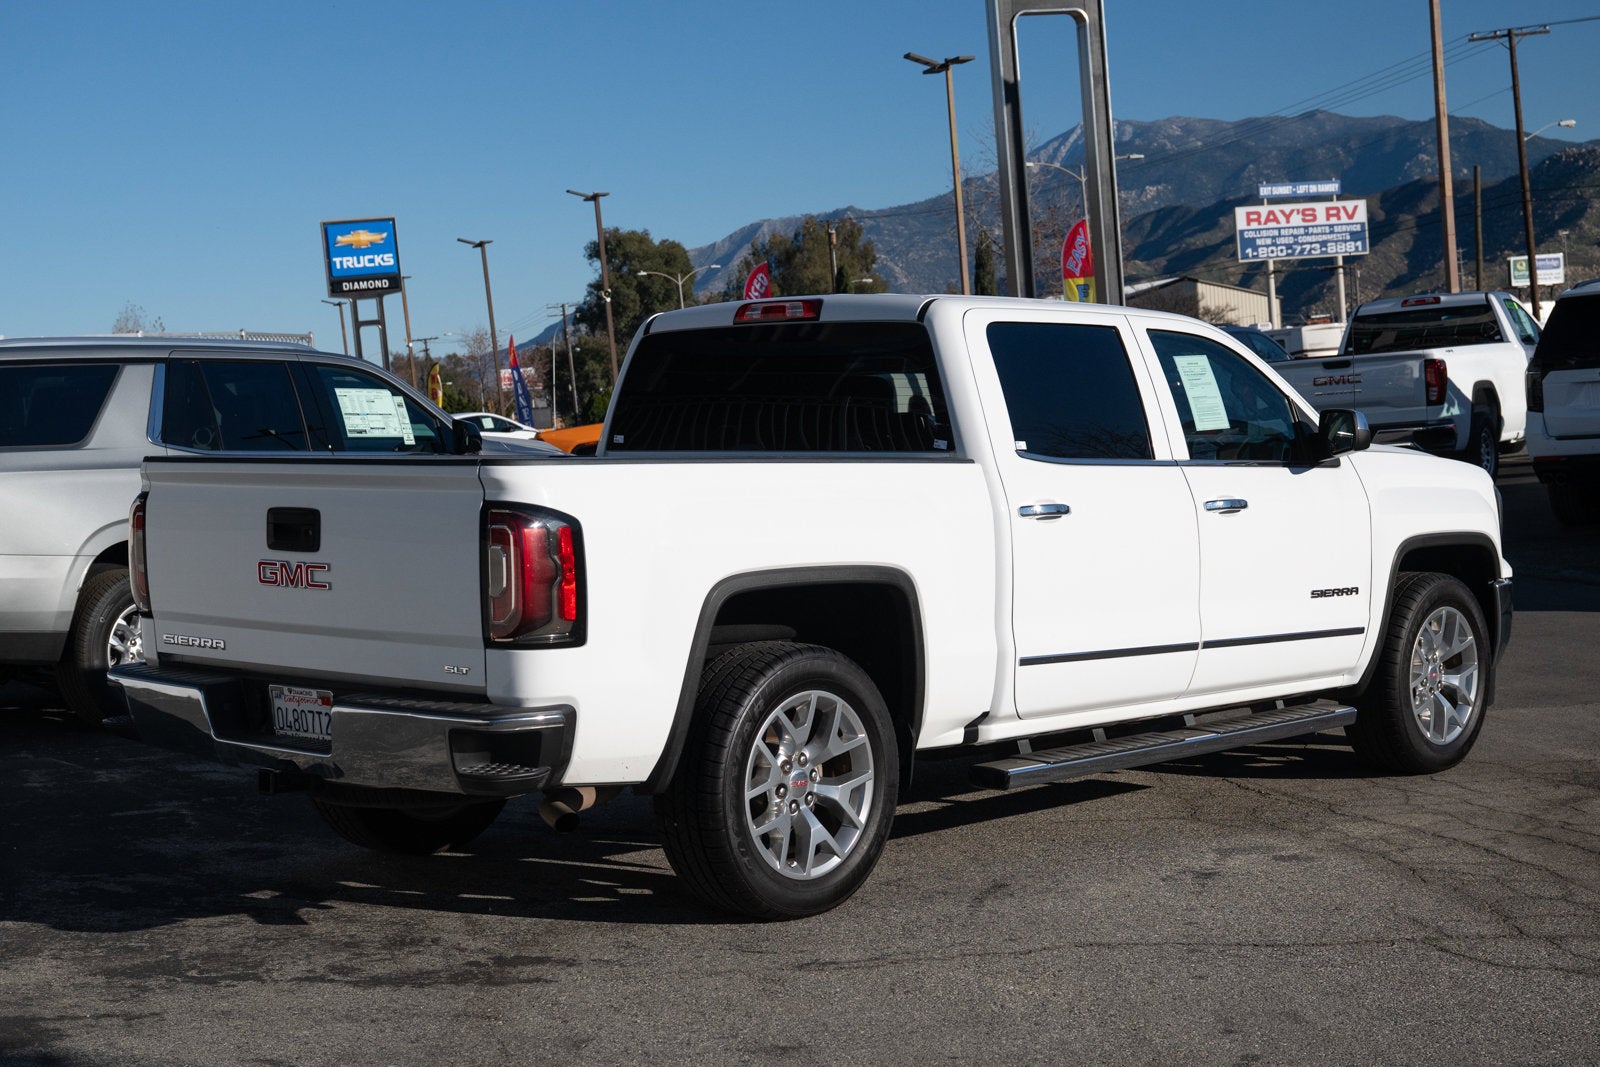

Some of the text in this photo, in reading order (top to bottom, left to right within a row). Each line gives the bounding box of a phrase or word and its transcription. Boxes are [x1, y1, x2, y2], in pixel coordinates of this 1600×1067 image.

[1272, 185, 1293, 195] SUNSET
[1296, 184, 1309, 194] LEFT
[1309, 184, 1317, 193] ON
[1245, 205, 1358, 226] RAY'S RV
[1243, 223, 1361, 238] COLLISION REPAIR PARTS SERVICE
[1256, 237, 1272, 246] NEW
[1276, 236, 1294, 245] USED
[1245, 241, 1362, 258] 1-800-773-8881
[332, 253, 394, 269] TRUCKS
[342, 279, 389, 291] DIAMOND
[1313, 373, 1362, 387] GMC
[257, 560, 330, 589] GMC
[1310, 586, 1359, 599] SIERRA
[163, 634, 226, 650] SIERRA
[444, 665, 470, 675] SLT
[276, 706, 332, 736] 04807T2
